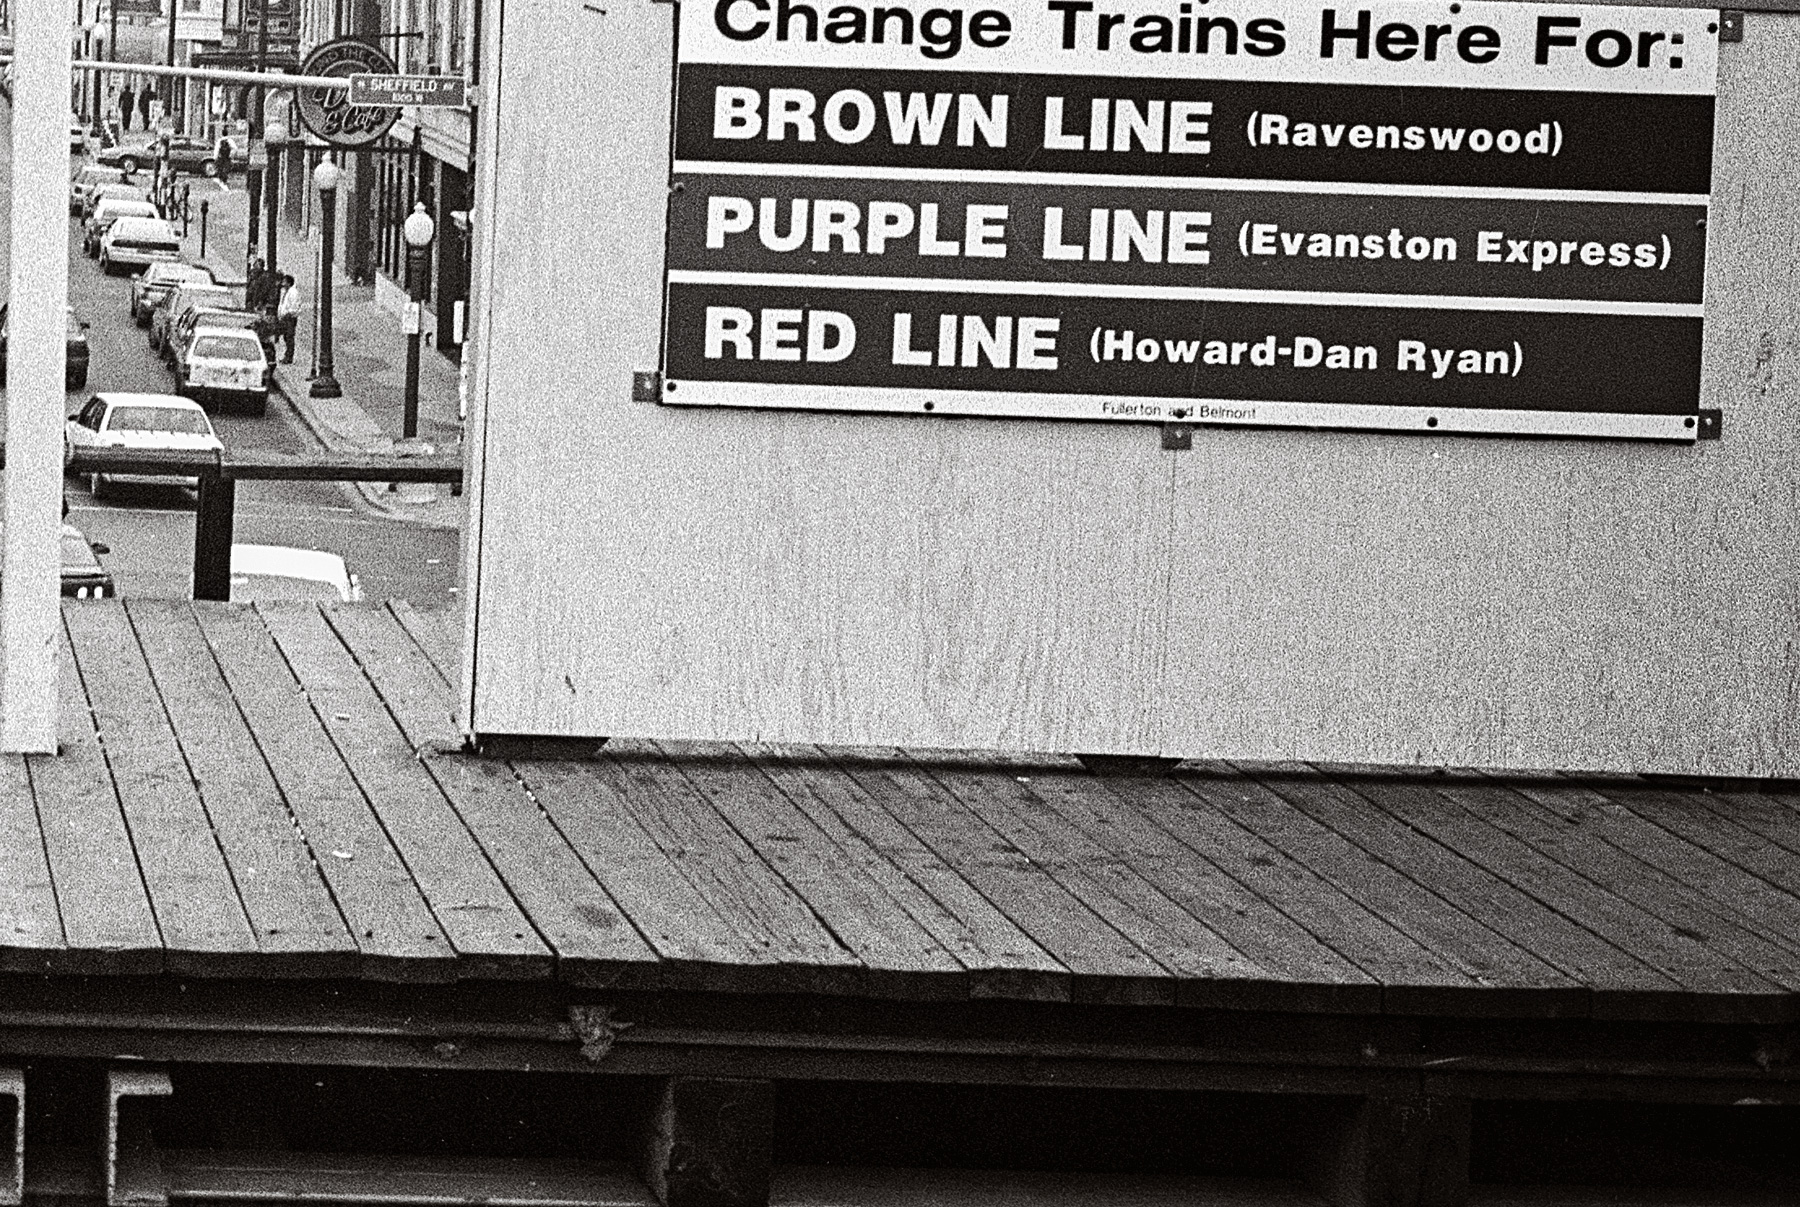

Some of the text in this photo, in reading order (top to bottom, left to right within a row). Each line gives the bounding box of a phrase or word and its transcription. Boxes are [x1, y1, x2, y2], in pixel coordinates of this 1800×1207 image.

[1320, 9, 1501, 64] Here
[1535, 15, 1684, 69] For:
[370, 78, 438, 92] SHEFFIELD
[714, 86, 1562, 155] BROWN LINE (Ravenswood)
[707, 196, 1671, 271] PURPLE LINE (Evanston Express)
[705, 307, 1522, 379] RED LINE (Howard-Dan Ryan)
[1102, 401, 1257, 420] Fullerton ad Belmont
